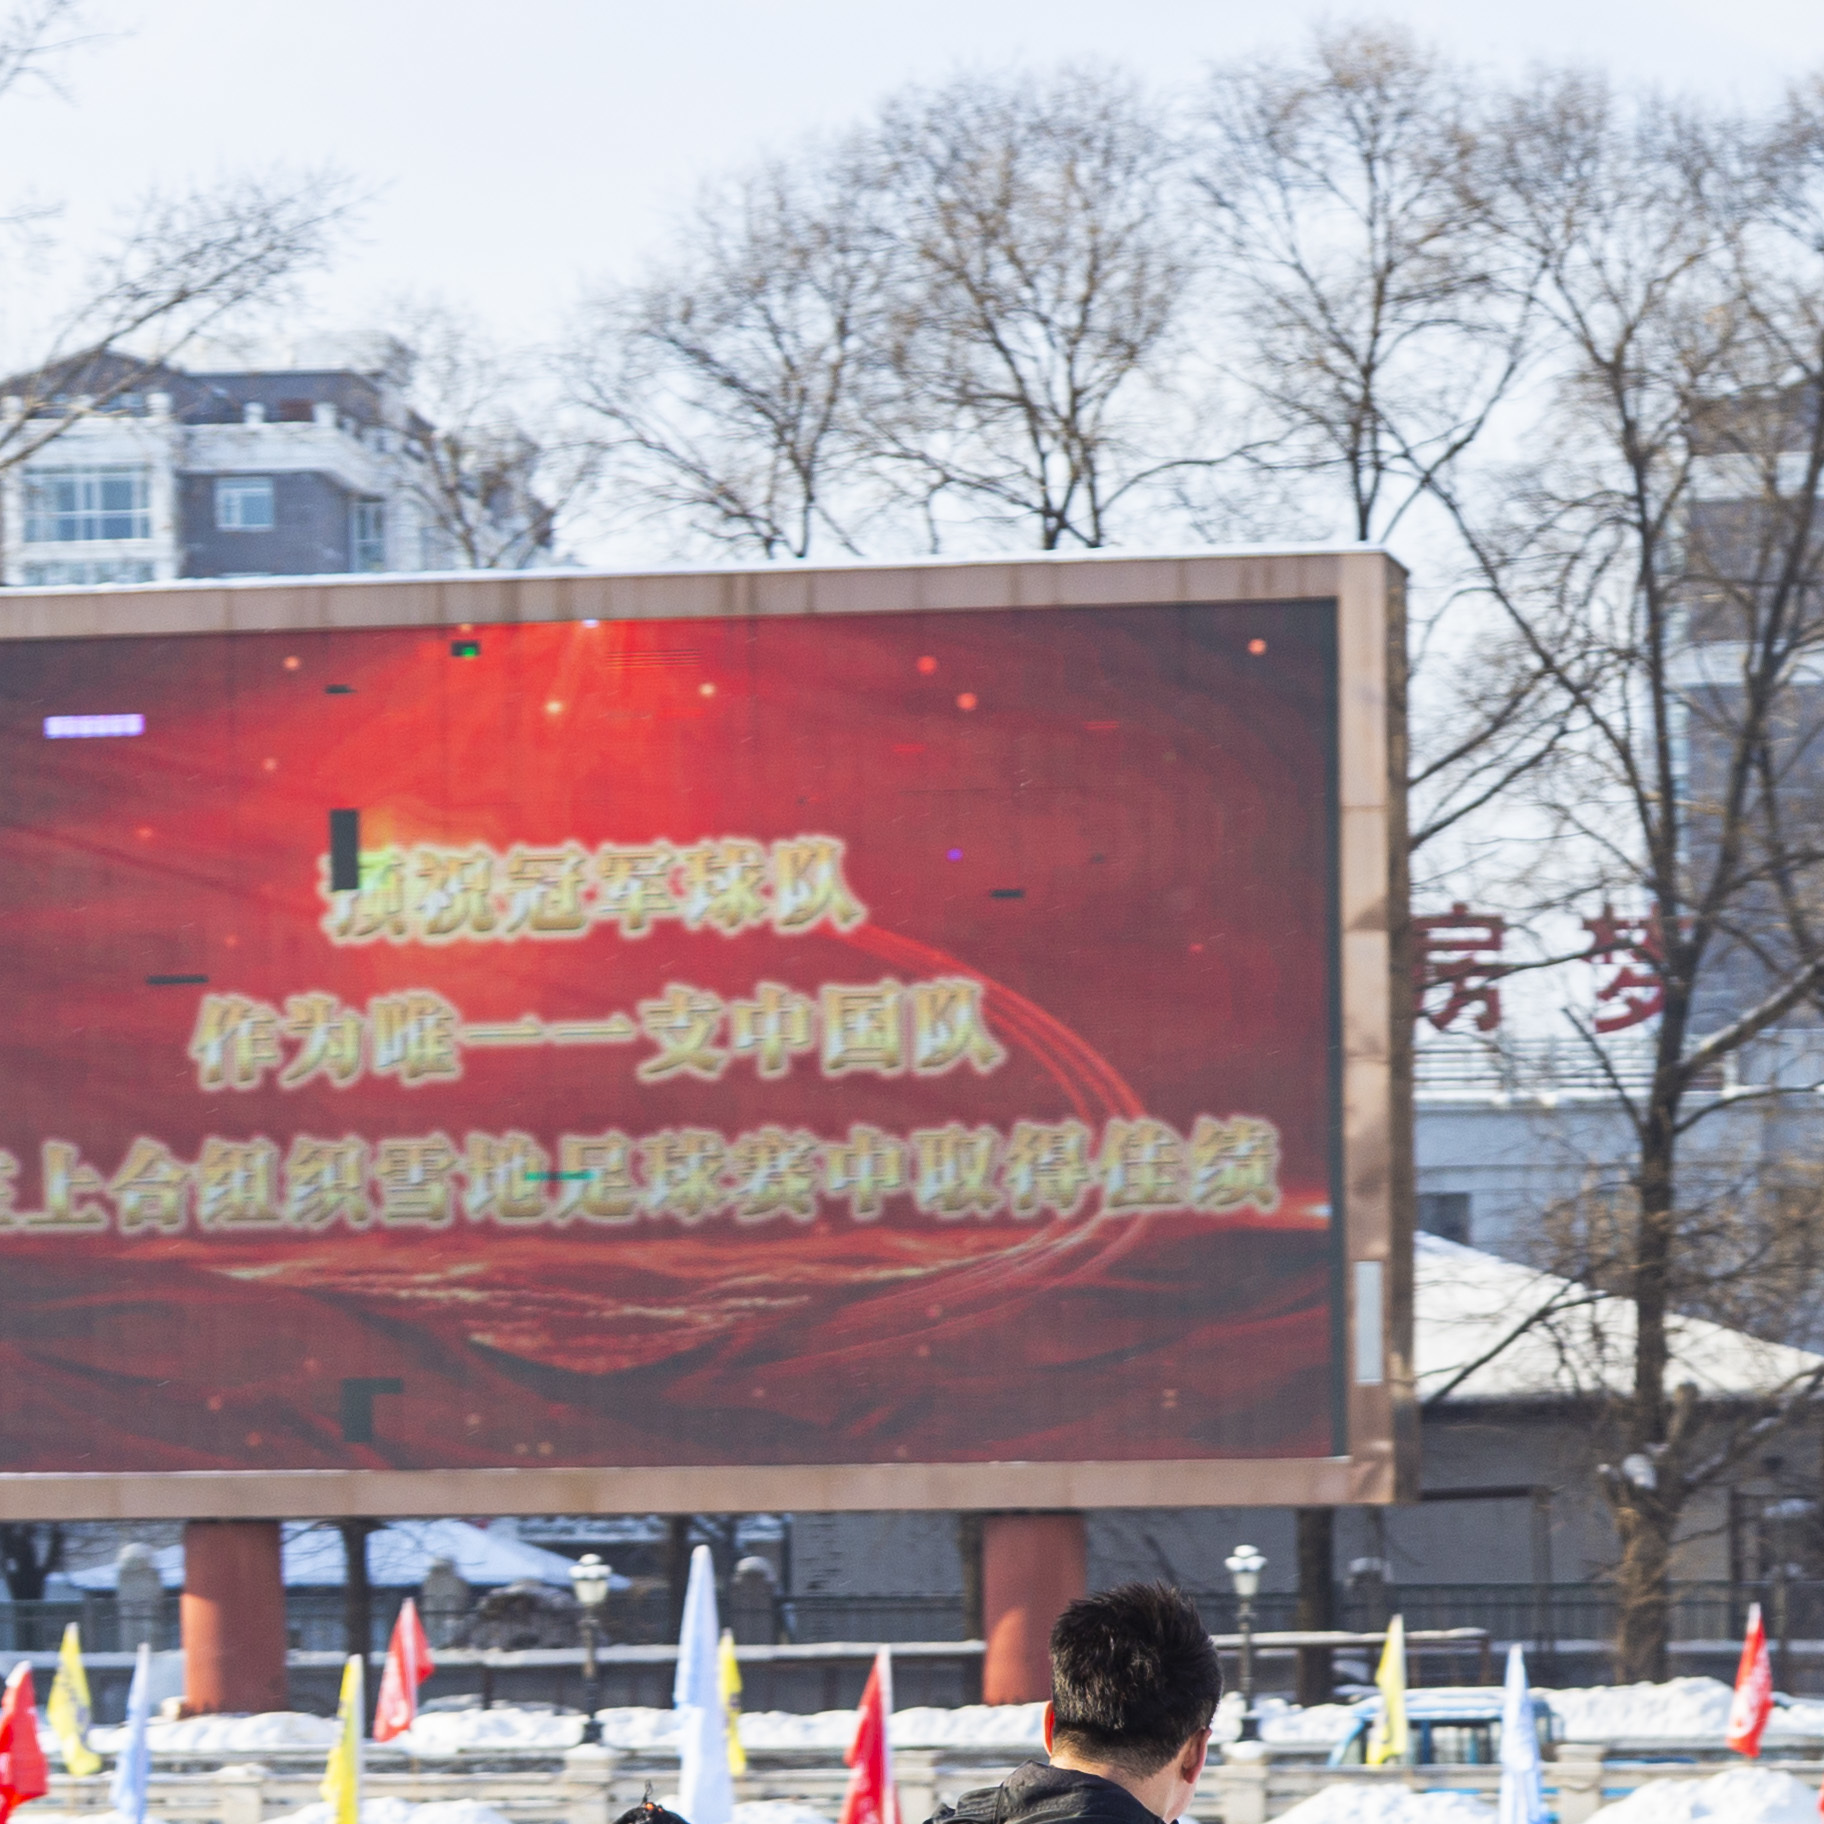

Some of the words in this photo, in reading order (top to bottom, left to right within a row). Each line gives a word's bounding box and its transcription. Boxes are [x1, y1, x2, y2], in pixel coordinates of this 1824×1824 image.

[324, 840, 864, 941] 预祝冠军球队
[194, 979, 1002, 1087] 作为唯一一支中国队
